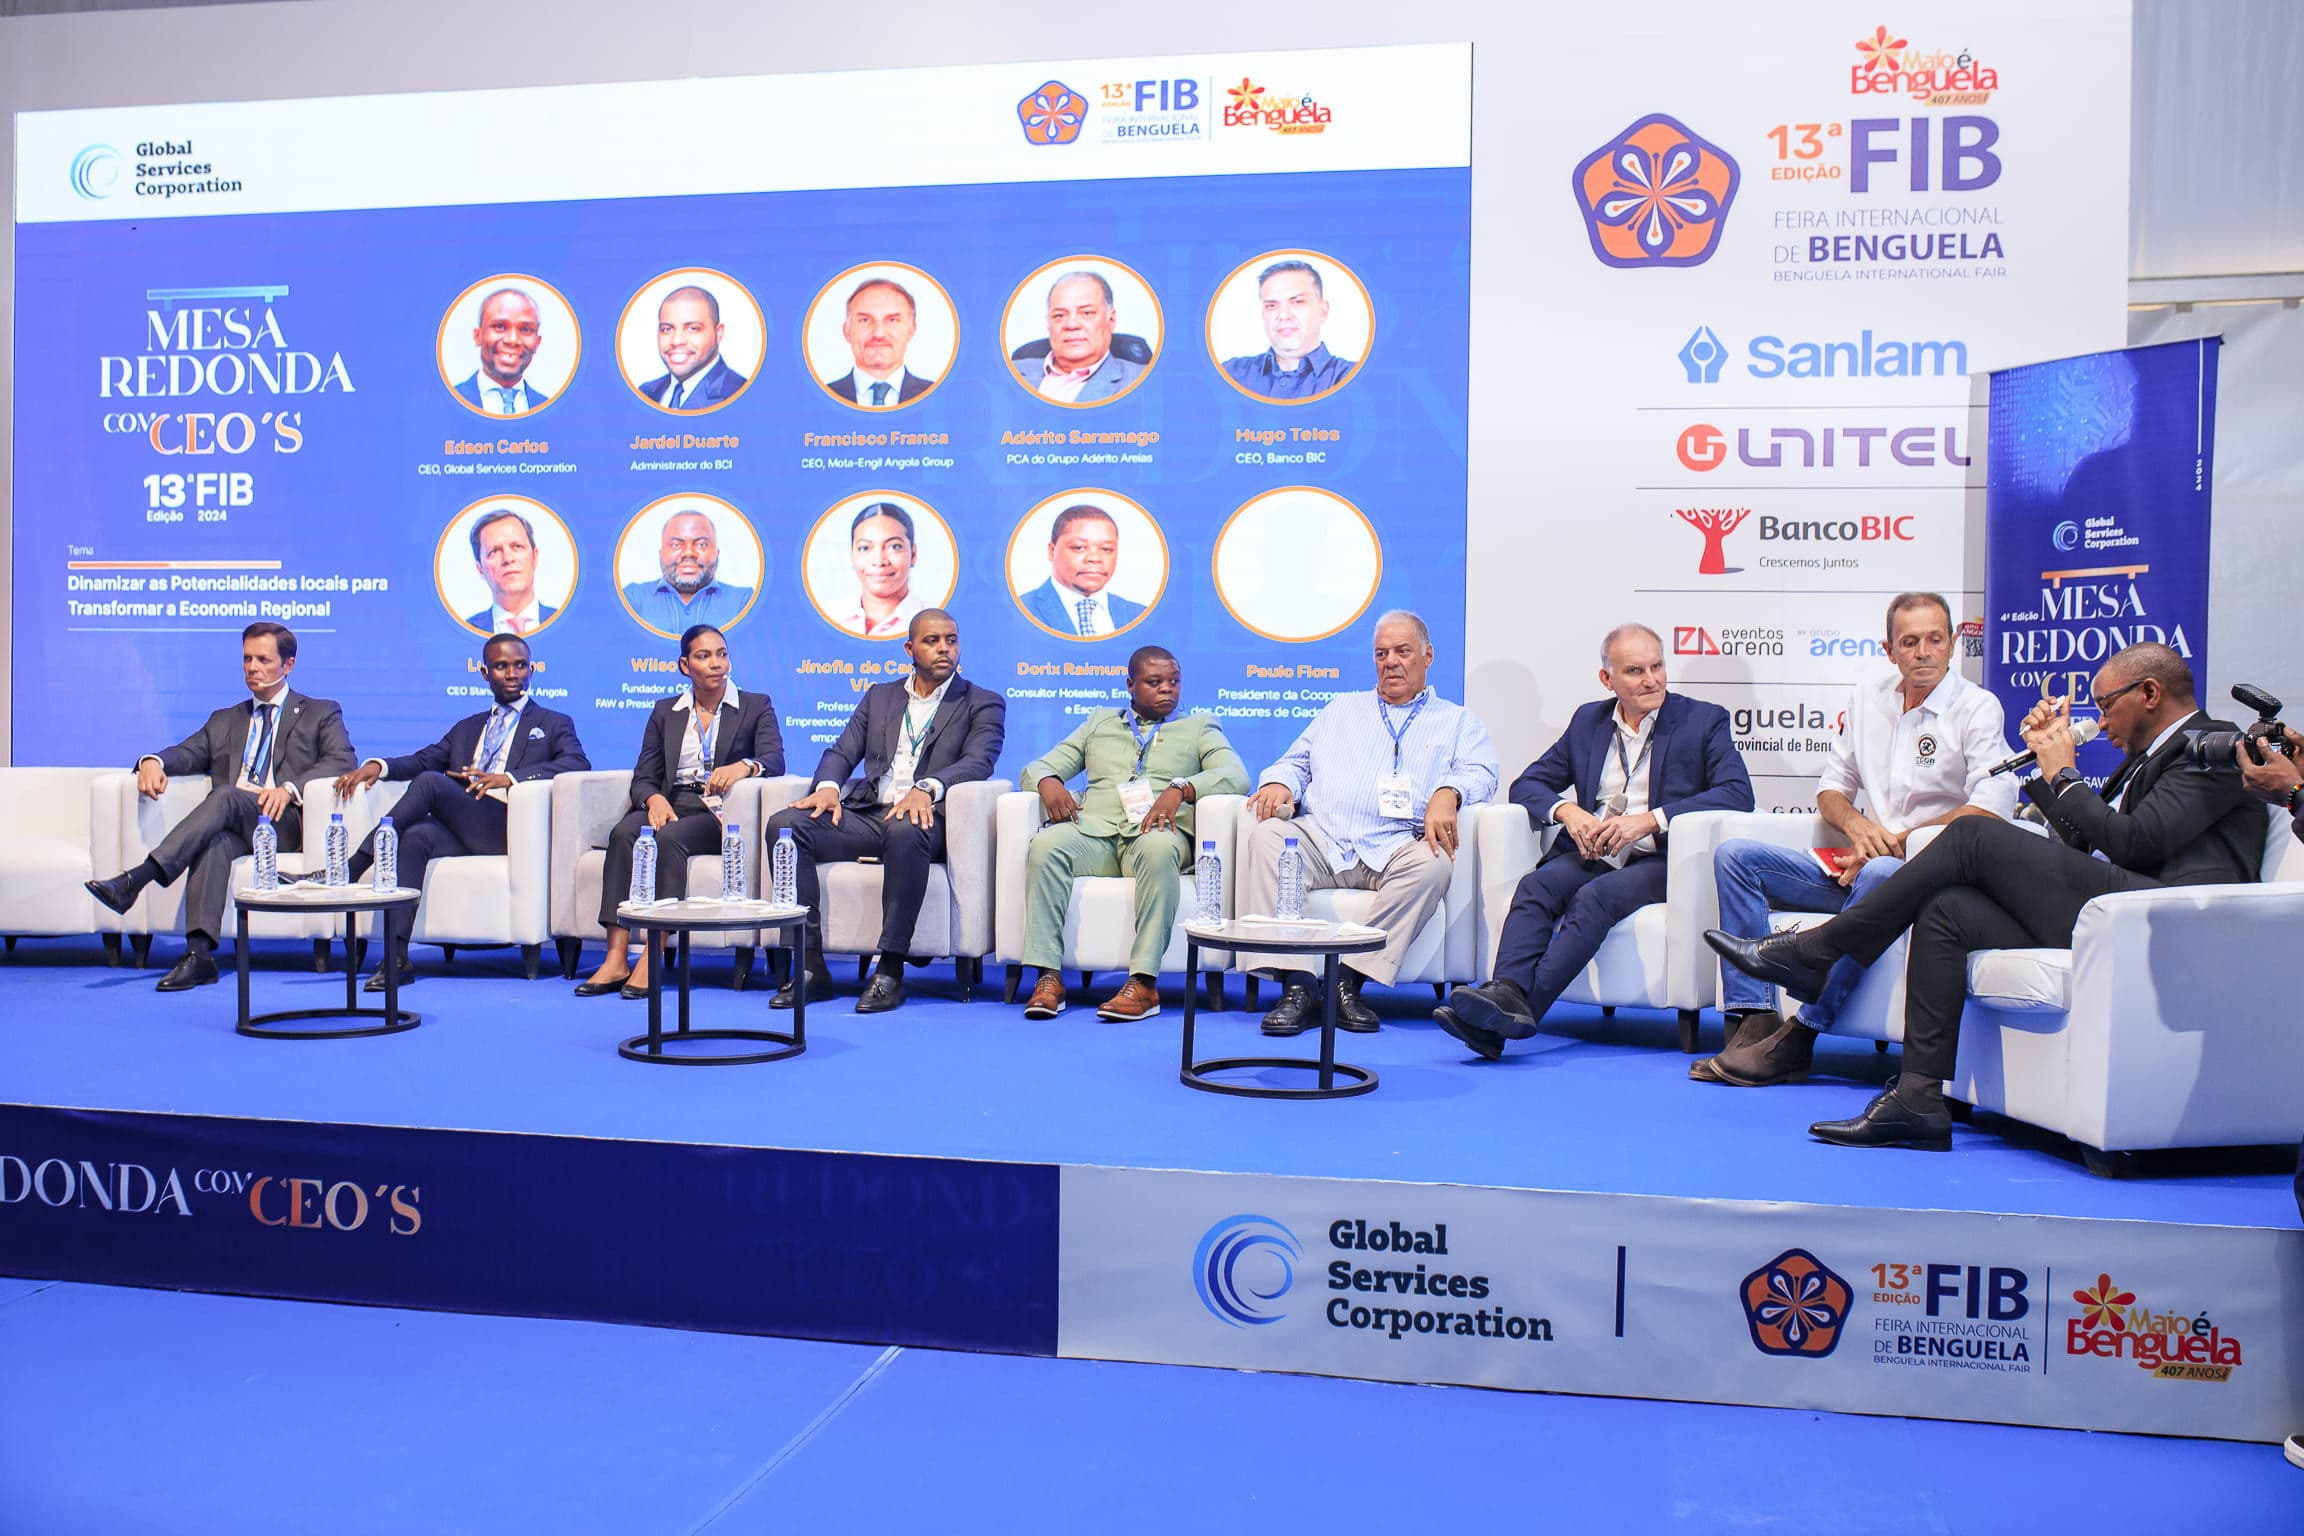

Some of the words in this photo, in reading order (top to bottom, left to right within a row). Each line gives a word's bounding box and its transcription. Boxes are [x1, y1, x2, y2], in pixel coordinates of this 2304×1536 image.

[1902, 49, 1956, 71] Maio
[1957, 47, 1973, 69] é
[1851, 60, 1999, 99] Benguela
[1135, 78, 1199, 112] FIB
[1931, 94, 1951, 104] 407
[1224, 101, 1332, 131] Benguela
[1117, 123, 1200, 137] BENGUELA
[135, 140, 193, 158] Global
[1767, 122, 1842, 160] 13ª
[1850, 115, 2003, 193] FIB
[135, 159, 212, 178] Services
[1771, 162, 1841, 183] EDIÇÃO
[135, 178, 243, 199] Corporation
[1774, 210, 1827, 230] FEIRA
[1836, 207, 2004, 228] INTERNACIONAL
[1774, 245, 1800, 264] DE
[1808, 232, 2005, 263] BENGUELA
[1774, 270, 1851, 281] BENGUELA
[1855, 267, 1970, 280] INTERNATIONAL
[1975, 266, 2007, 278] FAIR
[147, 306, 289, 352] MESA
[1747, 329, 1968, 378] Sanlam
[99, 350, 357, 398] REDONDA
[103, 411, 156, 434] CON
[630, 435, 681, 450] Jardel
[683, 434, 740, 448] Duarte
[804, 431, 888, 447] Francisco
[1001, 429, 1066, 446] Adérito
[1069, 430, 1160, 447] Saramago
[1235, 428, 1286, 446] Hugo
[1290, 427, 1341, 442] Teles
[444, 439, 495, 455] Edson
[497, 439, 549, 454] Carlos
[1738, 426, 1971, 467] UNITEL
[630, 460, 698, 472] Administrador
[699, 460, 713, 470] do
[714, 460, 733, 470] BCI
[801, 457, 825, 470] CEO,
[827, 457, 883, 471] Mota-Engil
[885, 457, 920, 471] Angola
[922, 456, 955, 470] Group
[1006, 453, 1030, 465] PCA
[1031, 453, 1045, 465] do
[1046, 453, 1080, 467] Grupo
[1081, 452, 1119, 465] Adérito
[1120, 452, 1154, 464] Areias
[1235, 452, 1264, 466] CEO,
[1266, 452, 1304, 465] Banco
[1305, 452, 1327, 464] BIC
[418, 464, 441, 476] CEO,
[443, 463, 474, 475] Global
[476, 463, 518, 474] Services
[519, 462, 577, 476] Corporation
[196, 472, 254, 506] FIB
[146, 508, 184, 523] Edição
[197, 509, 228, 522] 2024
[2085, 516, 2115, 529] Global
[1759, 515, 1915, 541] BancoBIC
[2084, 527, 2124, 539] Services
[67, 544, 95, 557] Tema
[2084, 536, 2140, 550] Corporation
[1759, 556, 1820, 569] Crescemos
[1823, 556, 1859, 570] Juntos
[67, 575, 146, 592] Dinamizar
[149, 579, 169, 592] as
[171, 575, 298, 592] Potencialidades
[300, 575, 349, 591] locais
[351, 578, 389, 595] para
[67, 600, 163, 617] Transformar
[166, 604, 177, 617] a
[179, 600, 258, 617] Economia
[260, 600, 331, 620] Regional
[2041, 583, 2147, 622] MESA
[2012, 610, 2039, 623] Edição
[1722, 627, 1784, 640] eventos
[1722, 639, 1784, 656] arena
[2001, 623, 2193, 664] REDONDA
[631, 656, 679, 672] Wilso
[860, 660, 882, 674] de
[1017, 661, 1060, 676] Dorix
[1063, 662, 1129, 676] Raimun
[1247, 664, 1295, 679] Paulo
[1296, 664, 1340, 679] Flora
[446, 685, 468, 696] CEO
[535, 686, 568, 699] Angola
[621, 682, 666, 694] Fundador
[667, 685, 674, 693] e
[675, 683, 693, 694] CE
[1006, 687, 1057, 699] Consultor
[1058, 688, 1110, 701] Hoteleiro,
[1218, 688, 1281, 701] Presidente
[1282, 688, 1298, 701] da
[2011, 671, 2048, 688] CON
[2041, 671, 2099, 705] CE
[595, 698, 618, 709] FAW
[618, 701, 625, 709] e
[1064, 705, 1073, 715] e
[1214, 705, 1272, 718] Criadores
[1274, 706, 1289, 718] de
[1787, 738, 1801, 752] de
[194, 1168, 253, 1195] CON
[1328, 1218, 1449, 1256] Global
[1327, 1259, 1490, 1300] Services
[1871, 1262, 1923, 1290] 13ª
[1925, 1263, 2030, 1322] FIB
[1873, 1291, 1921, 1307] EDIÇÃO
[1325, 1297, 1554, 1342] Corporation
[2127, 1307, 2191, 1335] Maio
[2192, 1311, 2211, 1337] é
[1875, 1317, 1912, 1333] FEIRA
[1916, 1320, 2030, 1341] INTERNACIONAL
[1874, 1339, 1892, 1354] DE
[1897, 1335, 2030, 1363] BENGUELA
[2067, 1318, 2243, 1371] Benguela
[1873, 1354, 1926, 1368] BENGUELA
[1927, 1358, 2006, 1373] INTERNACIONAL
[2008, 1364, 2031, 1374] FAIR
[2161, 1365, 2185, 1377] 407
